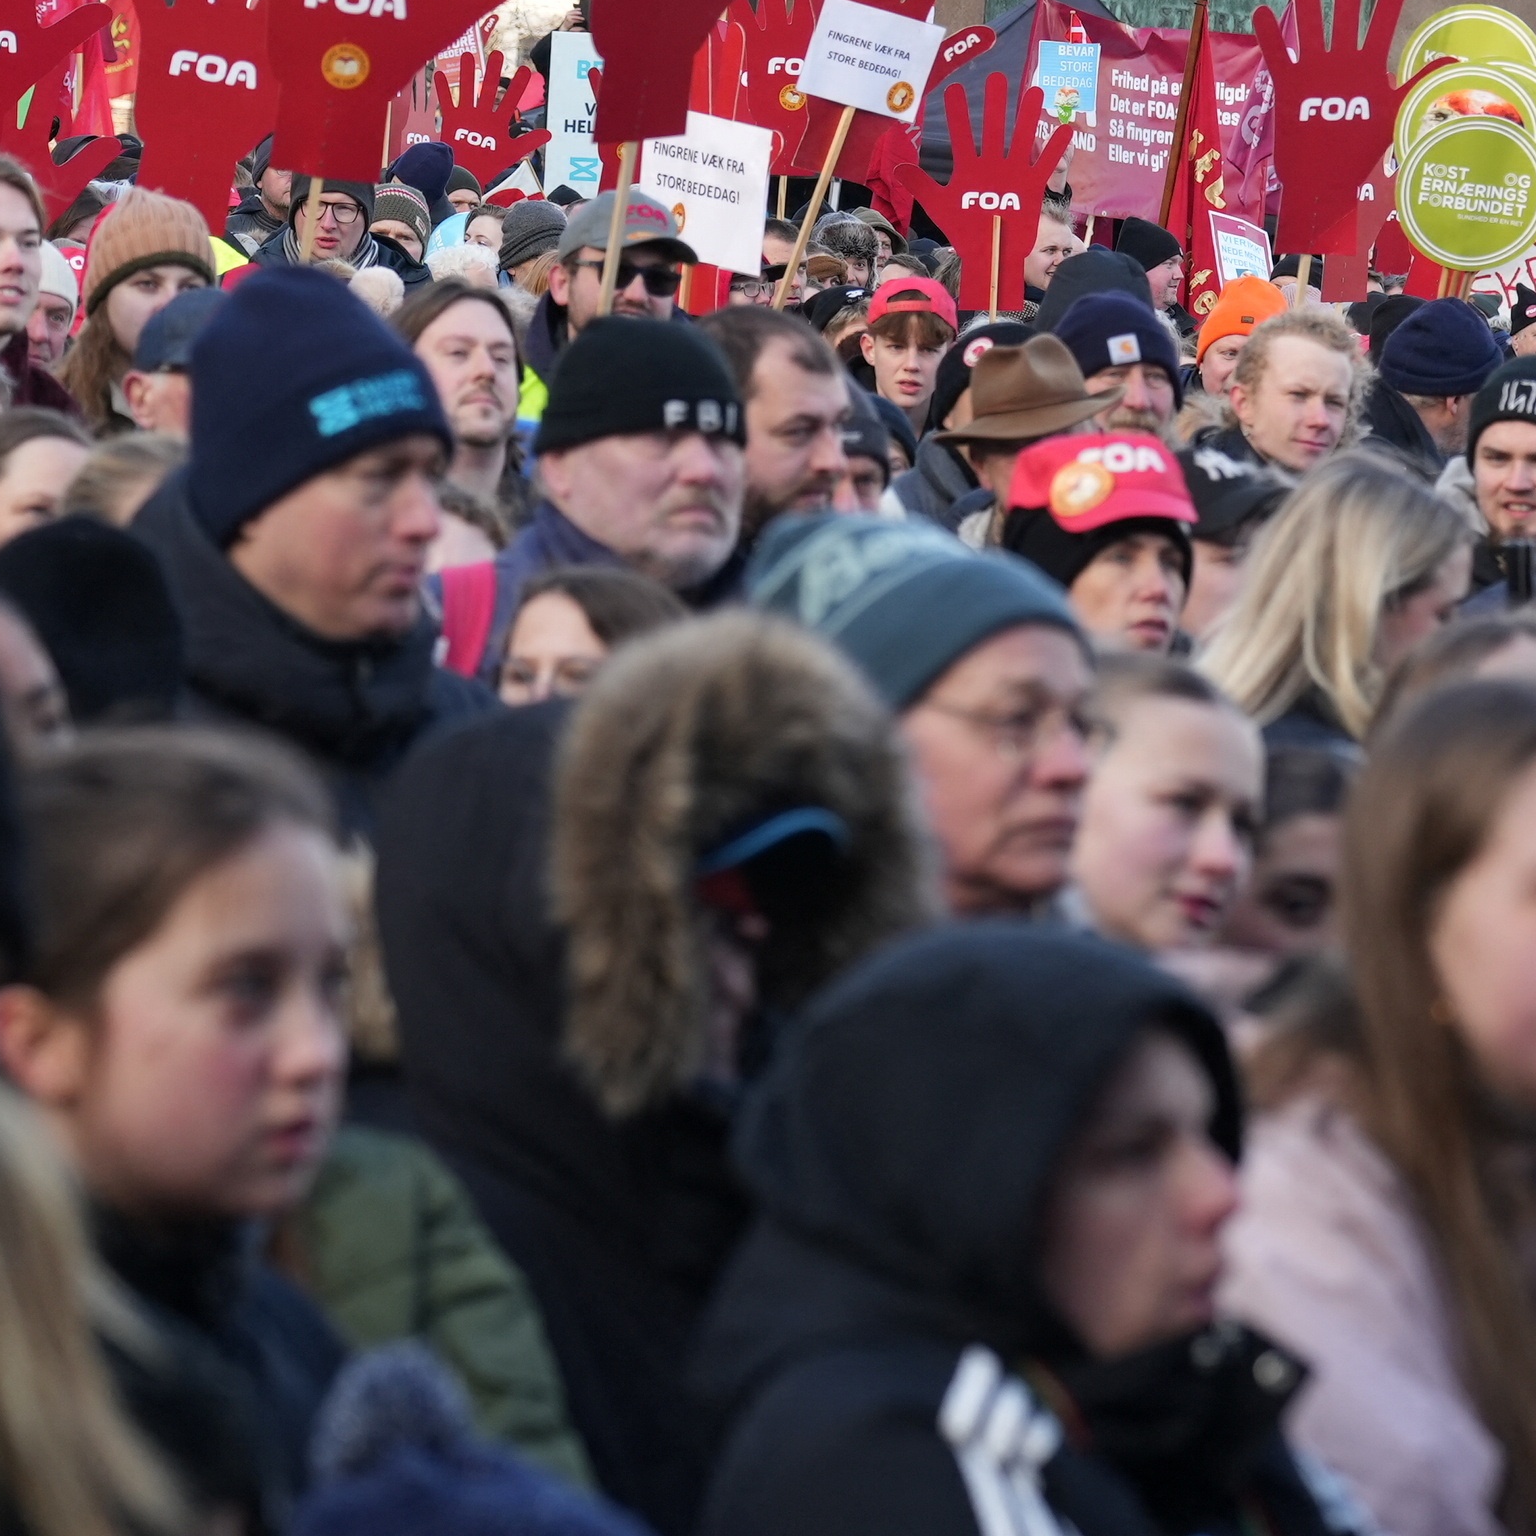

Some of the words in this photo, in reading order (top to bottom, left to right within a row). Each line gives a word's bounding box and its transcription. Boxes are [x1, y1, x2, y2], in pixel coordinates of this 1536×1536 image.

[827, 29, 871, 51] FINGRENE
[874, 42, 893, 56] VÆK
[894, 47, 910, 62] FRA
[943, 33, 981, 63] FOA
[1058, 45, 1094, 57] BEVAR
[168, 49, 257, 90] FOA
[767, 56, 805, 75] FO
[827, 50, 857, 66] STORE
[857, 59, 901, 80] BEDEDAG!
[1059, 60, 1093, 73] STORE
[1042, 75, 1092, 88] BEDEDAG
[1111, 69, 1149, 93] Frihed
[1151, 77, 1168, 97] på
[1110, 94, 1131, 113] Det
[1133, 101, 1146, 116] er
[1217, 108, 1240, 126] tes
[1299, 96, 1370, 122] FOA
[454, 128, 496, 151] FOA
[564, 120, 595, 134] HEL
[1109, 119, 1125, 138] Så
[1127, 123, 1174, 147] fingren
[654, 141, 698, 163] FINGRENE
[701, 152, 724, 171] VÆK
[727, 158, 745, 175] FRA
[1108, 143, 1134, 164] Eller
[1137, 148, 1149, 166] vi
[1423, 162, 1470, 181] KOST
[1505, 173, 1531, 189] OG
[656, 173, 687, 191] STORE
[687, 182, 740, 205] BEDEDAG!
[961, 191, 1020, 211] FOA
[1421, 178, 1528, 203] ERNÆRINGS
[1418, 192, 1527, 218] FORBUNDET
[1222, 245, 1244, 258] NEDE
[1223, 257, 1247, 269] HVEDE
[664, 399, 737, 435] FBI
